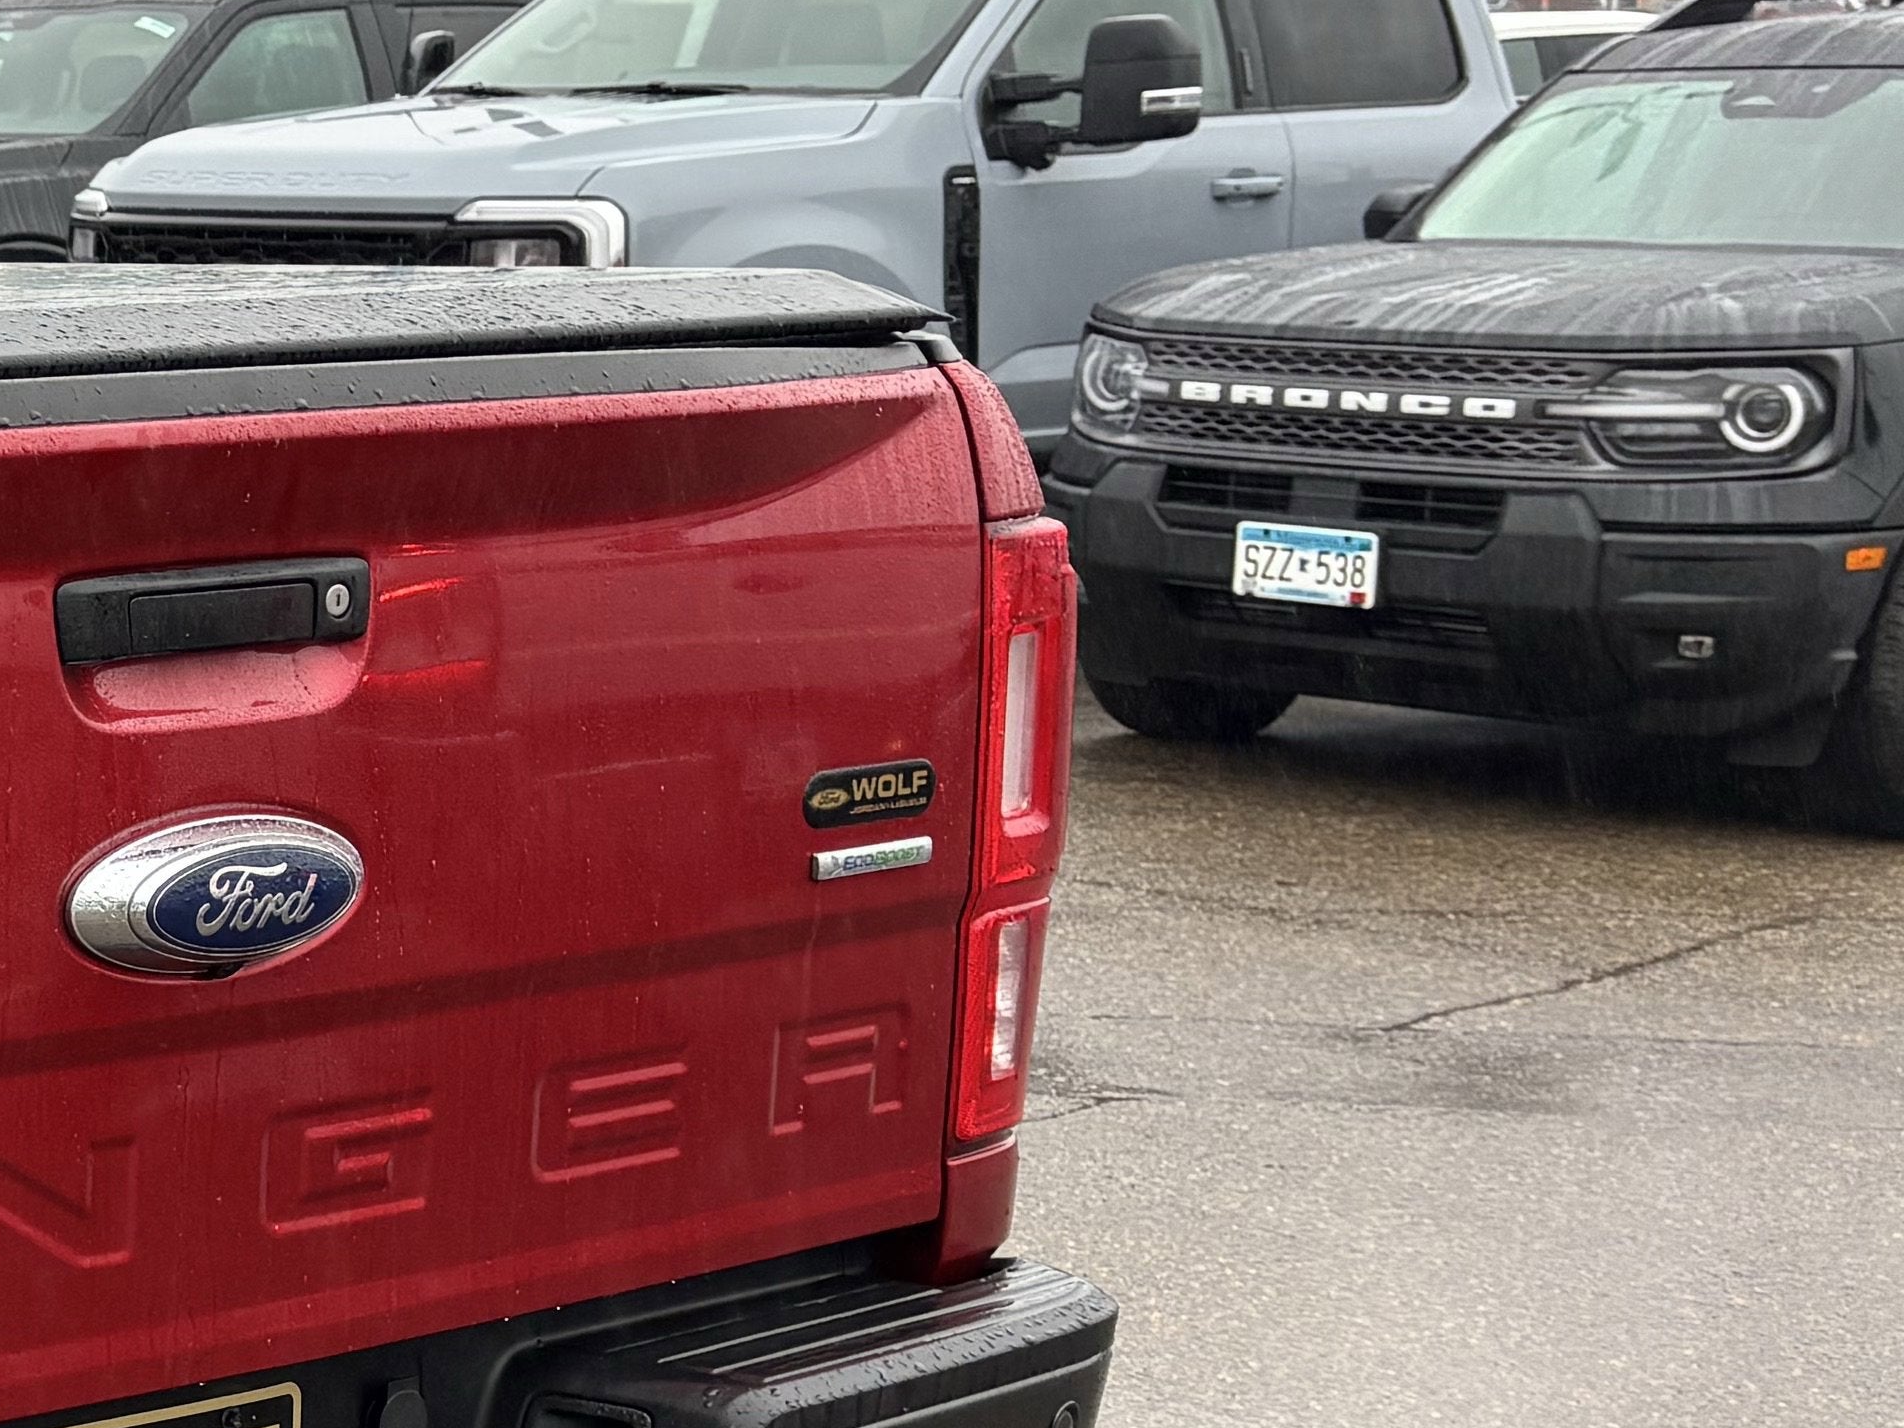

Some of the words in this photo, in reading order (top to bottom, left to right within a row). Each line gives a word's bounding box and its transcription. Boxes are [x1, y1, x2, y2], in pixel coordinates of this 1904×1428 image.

[1180, 380, 1516, 419] BRONCO
[1243, 544, 1294, 582] SZZ
[1315, 549, 1366, 589] 538
[852, 770, 928, 801] WOLF
[195, 861, 318, 937] Ford
